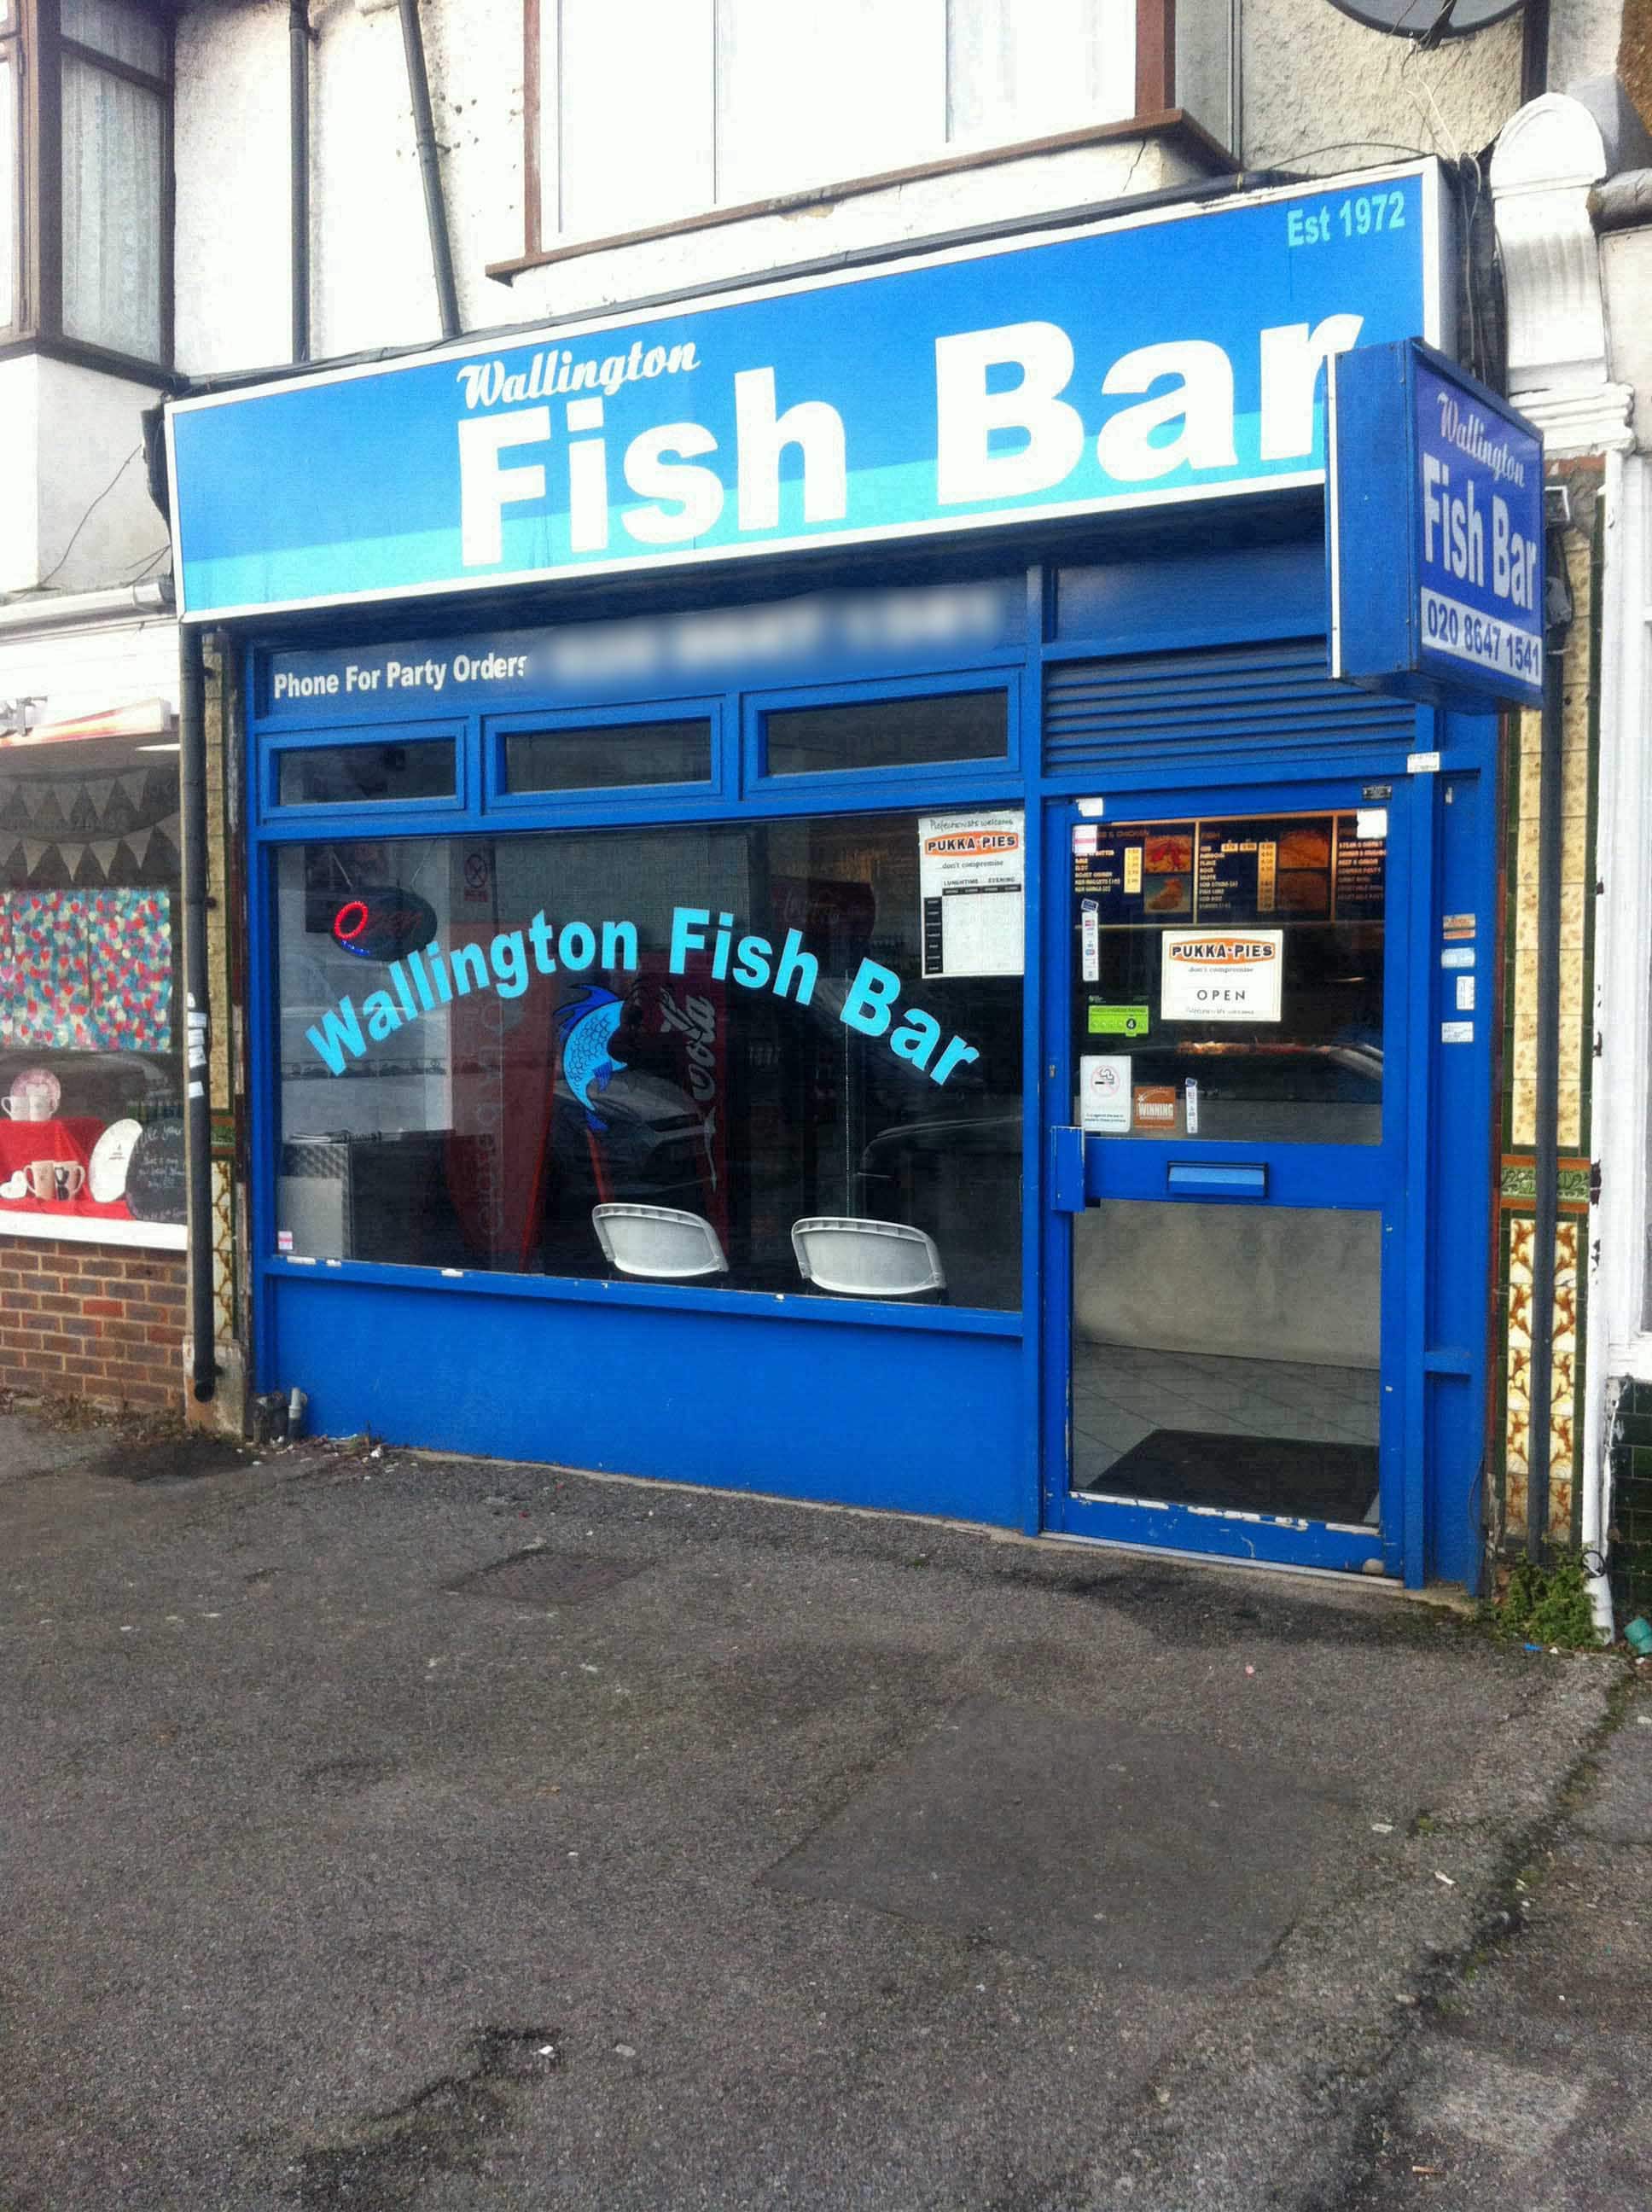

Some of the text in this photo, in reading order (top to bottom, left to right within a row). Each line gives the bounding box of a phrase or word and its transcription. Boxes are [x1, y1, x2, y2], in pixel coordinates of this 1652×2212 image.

[1287, 191, 1406, 247] Est 1972
[457, 340, 701, 410] Wallington
[458, 313, 1364, 568] Fish Bar
[1437, 392, 1526, 489] Wallington
[1423, 452, 1537, 610] Fish Bar
[1428, 599, 1539, 676] 020 8647 1541
[274, 672, 339, 699] Phone
[346, 666, 381, 692] For
[387, 659, 446, 690] Party
[305, 909, 638, 1076] Wallington
[669, 906, 819, 1006] Fish
[839, 957, 980, 1086] Bar
[1196, 989, 1246, 1001] OPEN
[1138, 1103, 1174, 1117] WINNING
